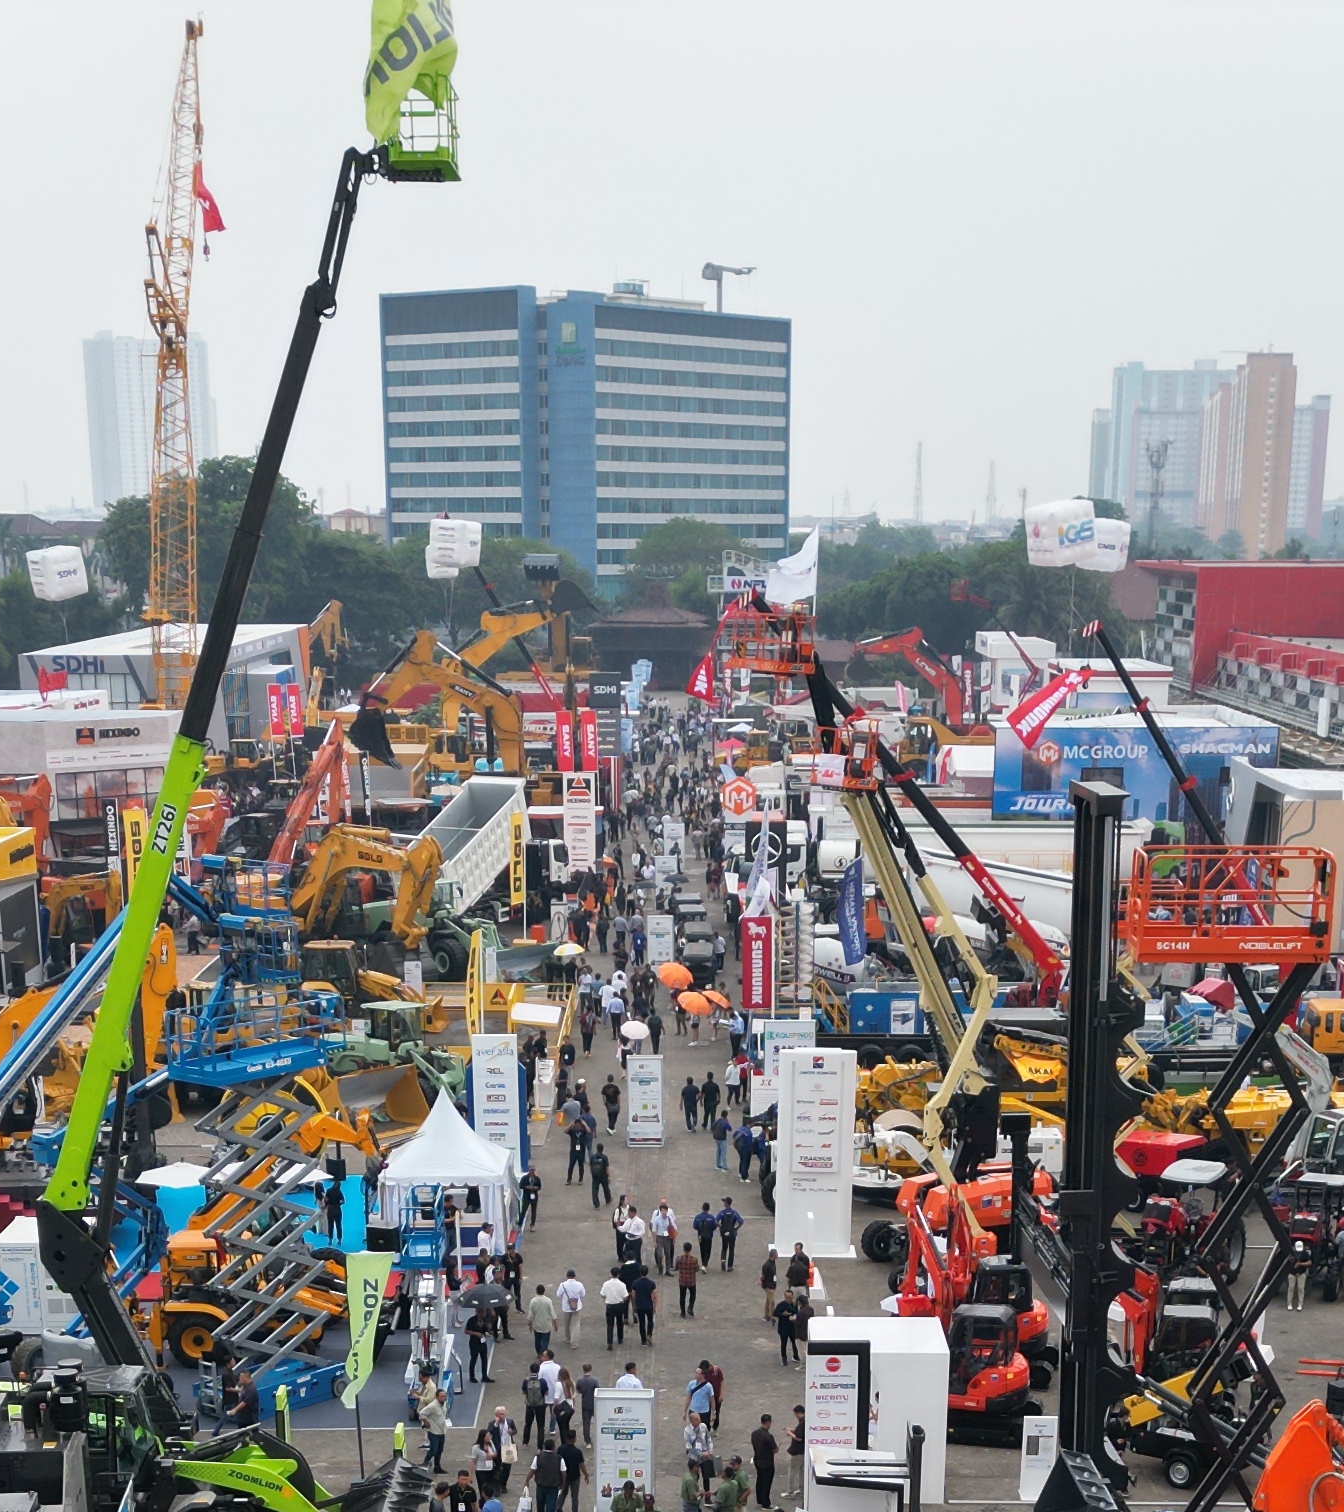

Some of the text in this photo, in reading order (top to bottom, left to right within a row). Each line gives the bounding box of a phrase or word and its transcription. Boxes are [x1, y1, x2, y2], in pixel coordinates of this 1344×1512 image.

[563, 723, 572, 758] SANY
[587, 723, 596, 758] SANY
[1179, 743, 1271, 754] SHACMAN
[1156, 941, 1191, 950] SC14H
[1239, 941, 1303, 951] NOBLELIFT
[228, 1469, 284, 1496] ZOOMLION
